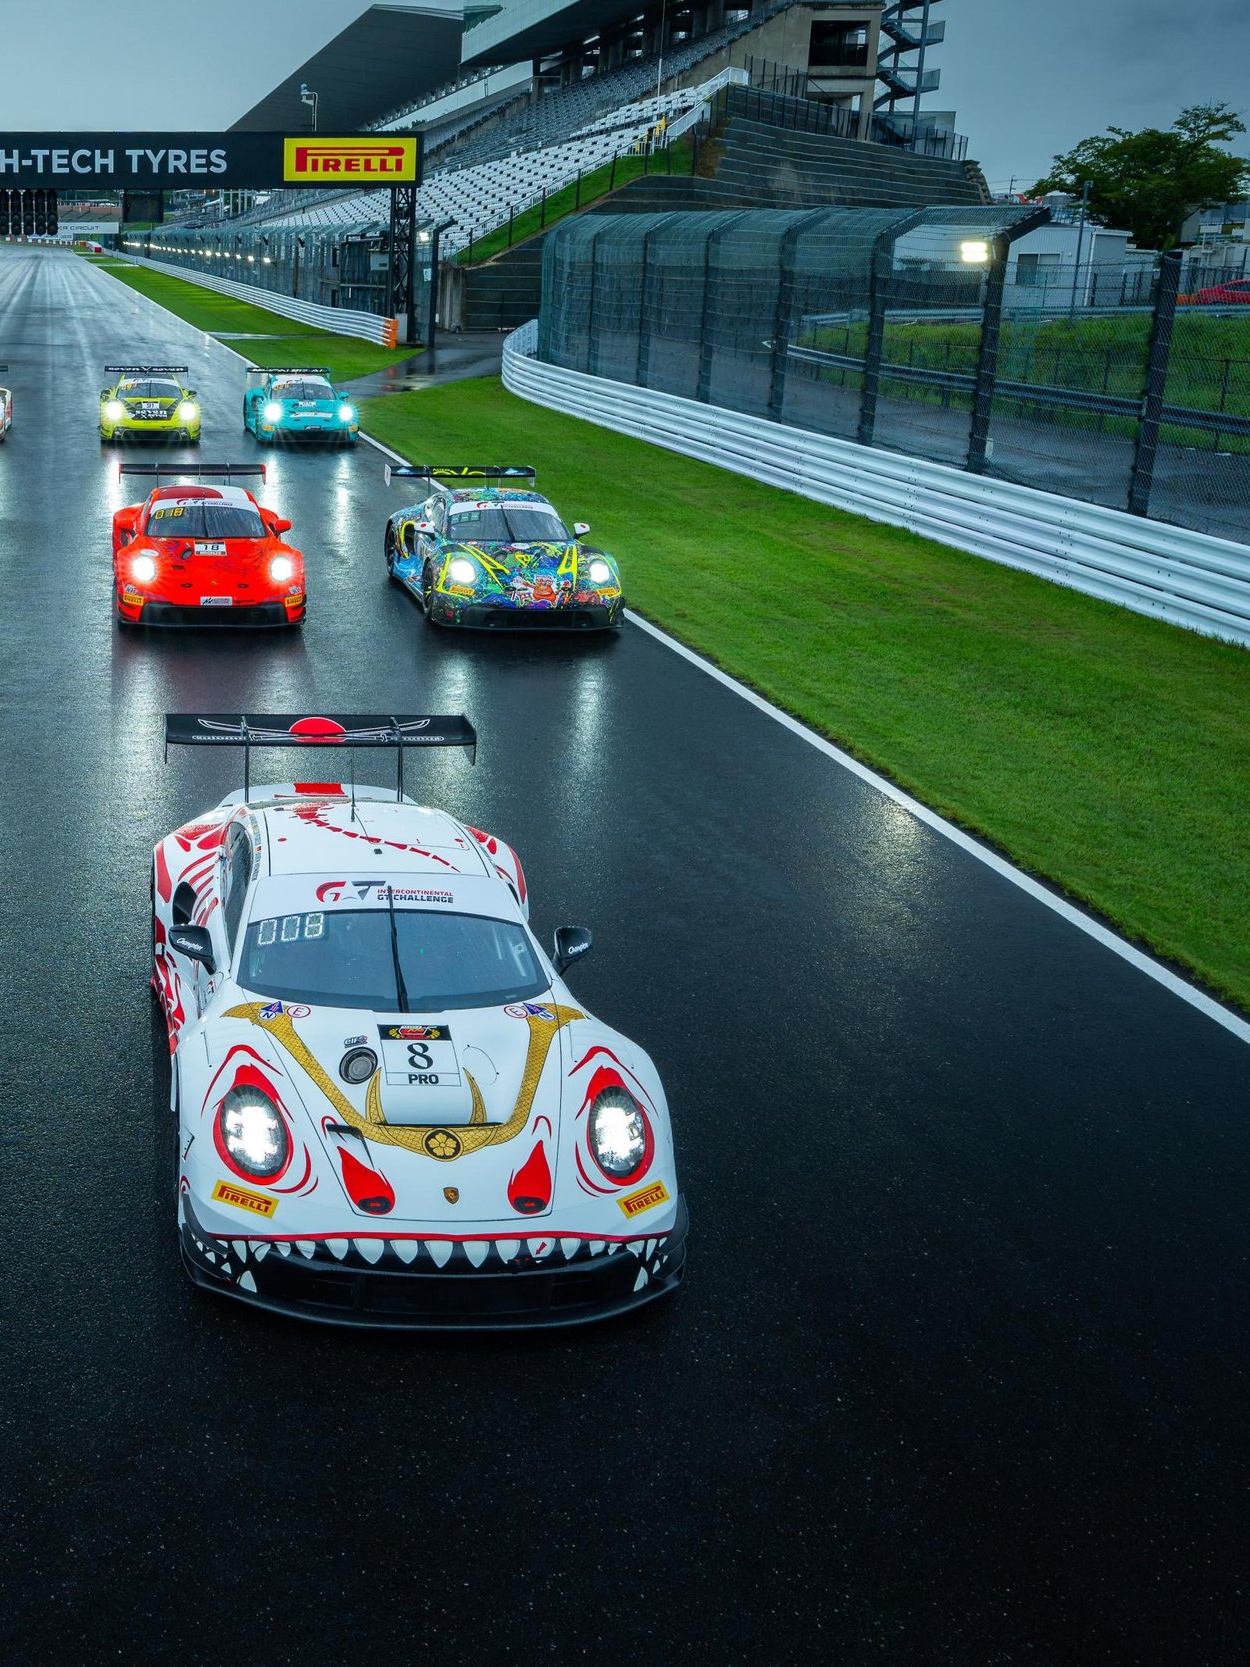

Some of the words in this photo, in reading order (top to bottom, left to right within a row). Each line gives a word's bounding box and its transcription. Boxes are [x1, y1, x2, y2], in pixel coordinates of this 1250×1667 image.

[125, 149, 227, 175] TYRES
[294, 146, 404, 173] PIRELLI
[393, 895, 454, 903] CHALLENGE
[257, 913, 324, 946] 008
[407, 1042, 433, 1069] 8
[408, 1074, 439, 1085] PRO
[218, 1185, 272, 1213] PIRELLI
[623, 1185, 665, 1214] PIRELLI
